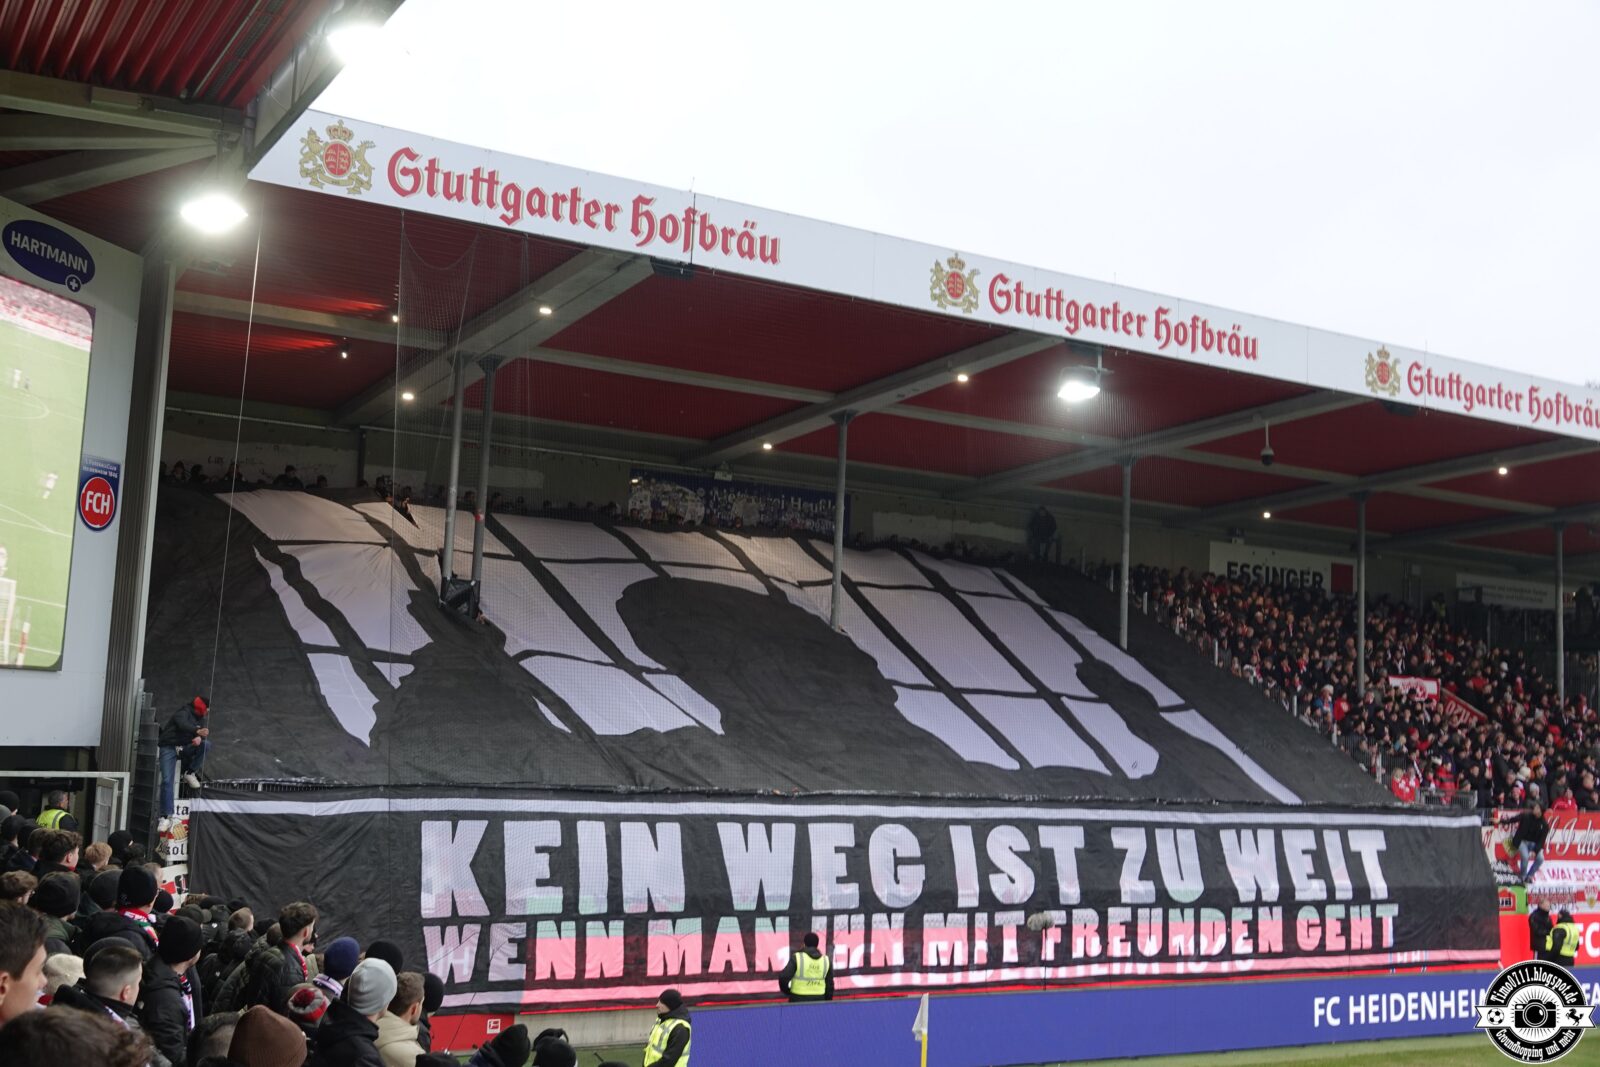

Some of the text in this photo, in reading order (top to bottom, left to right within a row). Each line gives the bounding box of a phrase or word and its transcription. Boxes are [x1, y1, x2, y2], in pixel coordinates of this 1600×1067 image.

[387, 146, 781, 265] Stuttgarter Hofbräu
[11, 230, 88, 274] HARTMANN
[988, 272, 1260, 361] Stuttgarter Hofbräu
[1407, 361, 1523, 412] Stuttgarter
[85, 490, 111, 515] FCH
[1226, 561, 1325, 589] ESSINGER
[420, 819, 1389, 919] KEIN WEG IST ZU WEIT
[422, 919, 625, 985] WENN
[647, 915, 790, 978] MAN
[811, 912, 905, 970] IHN
[922, 909, 1025, 966] MIT
[1038, 905, 1284, 961] FREUNDEN
[1296, 903, 1399, 952] GEHT
[1313, 996, 1341, 1028] FC
